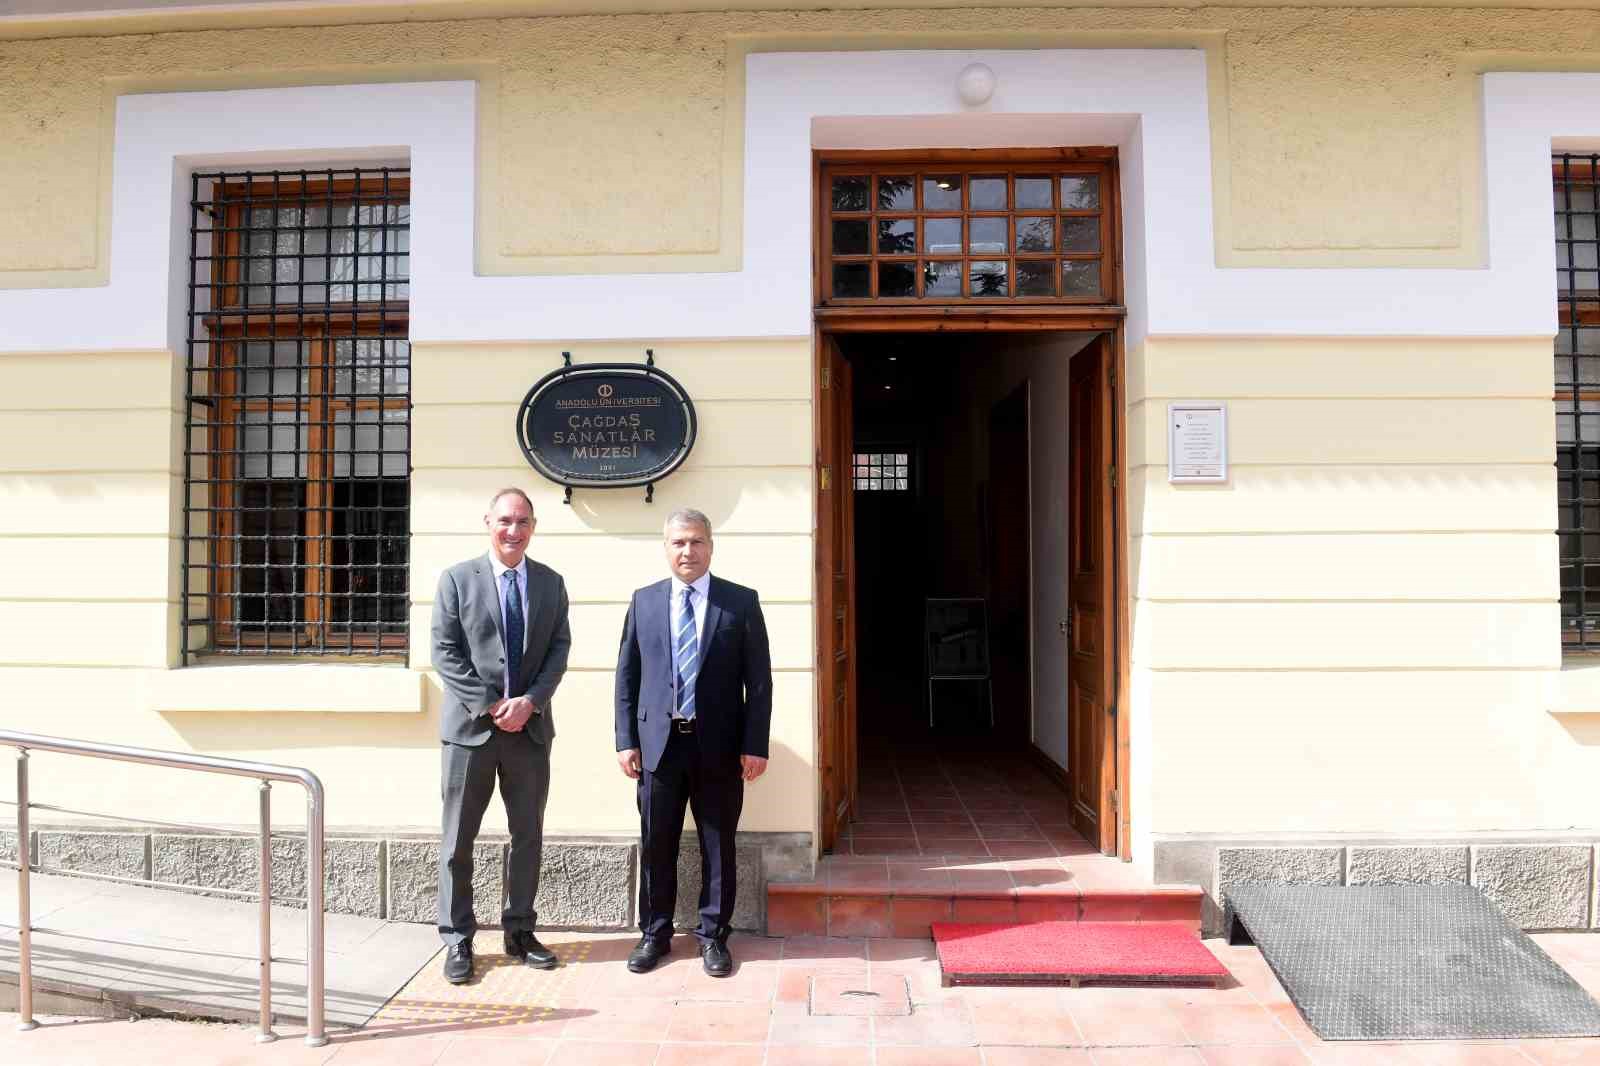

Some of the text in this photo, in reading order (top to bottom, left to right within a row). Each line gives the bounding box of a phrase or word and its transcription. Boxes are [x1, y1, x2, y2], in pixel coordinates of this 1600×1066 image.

[555, 399, 597, 408] ANADOLU
[568, 413, 640, 431] ÇAĞDAŞ
[553, 429, 656, 444] SANATLAR
[572, 444, 637, 459] MÜZESİ
